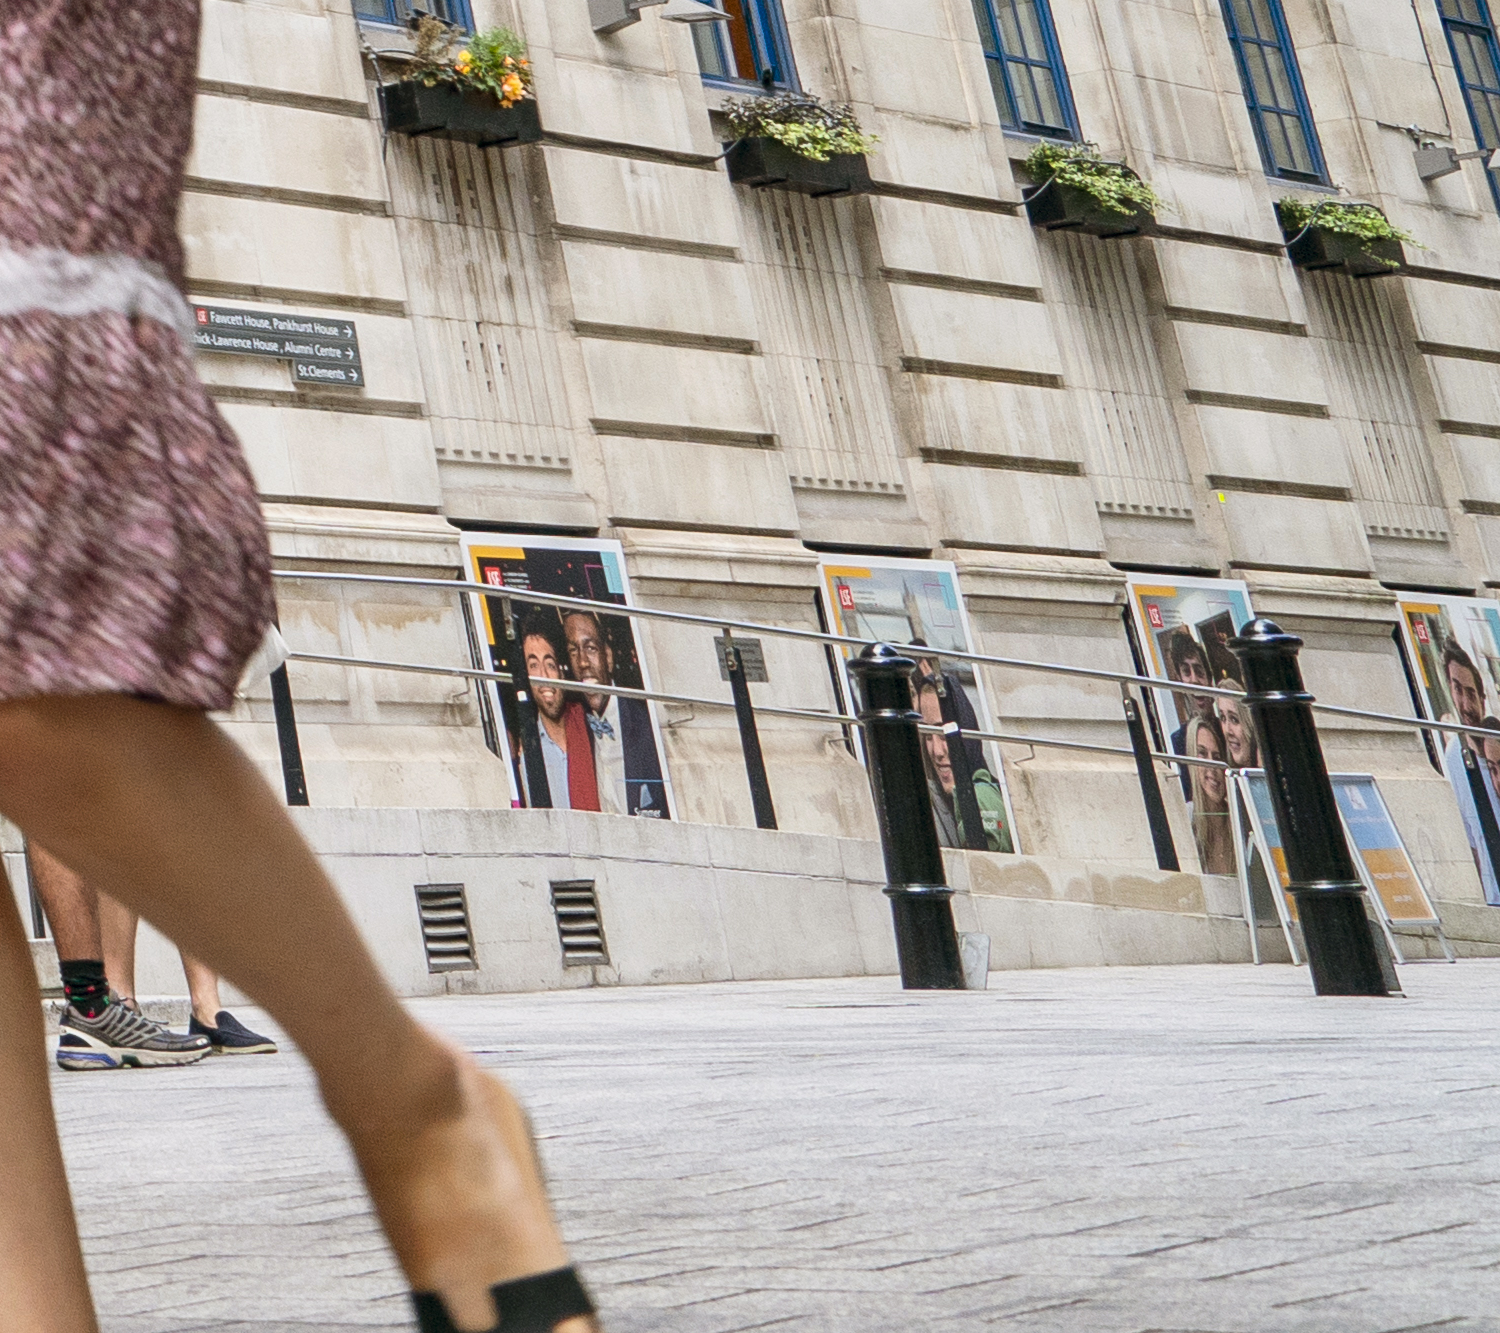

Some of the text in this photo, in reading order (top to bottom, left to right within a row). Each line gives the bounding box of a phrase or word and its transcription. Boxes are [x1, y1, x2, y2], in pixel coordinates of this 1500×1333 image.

[209, 311, 243, 326] Fawcett
[273, 318, 313, 333] Pankhurst
[314, 323, 339, 336] House
[284, 341, 313, 354] Alumni
[314, 345, 341, 358] Centre
